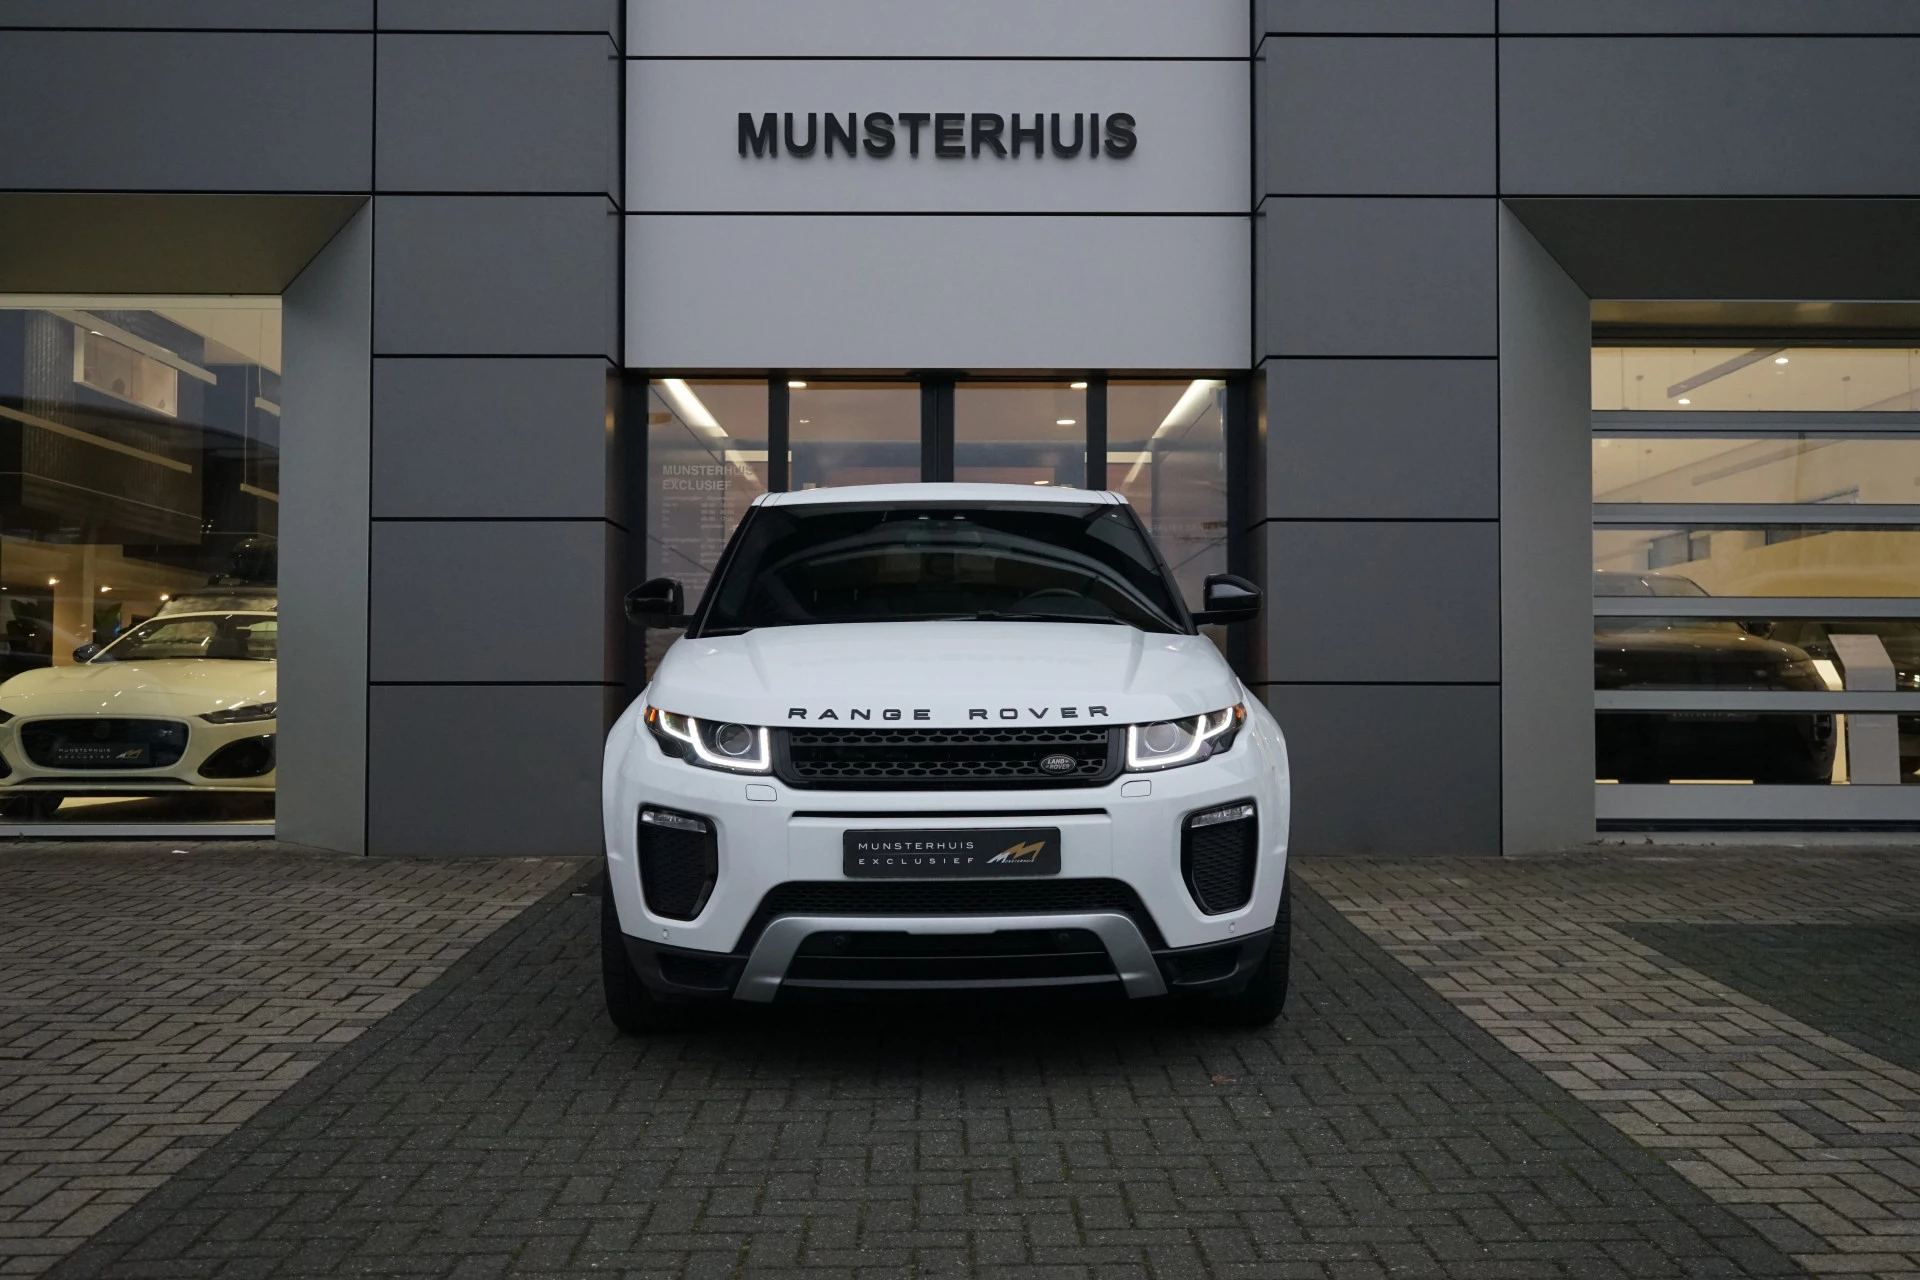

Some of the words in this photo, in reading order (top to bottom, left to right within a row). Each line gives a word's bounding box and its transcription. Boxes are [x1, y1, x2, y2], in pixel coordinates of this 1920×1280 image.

[737, 111, 1138, 158] MUNSTERHUIS
[662, 464, 752, 476] MUNSTERHUIS
[662, 480, 732, 491] EXCLUSIEF
[787, 707, 931, 721] RANGE
[968, 705, 1109, 720] ROVER
[858, 841, 974, 850] MUNSTERHUIS
[858, 857, 974, 865] EXCLUSIEF
